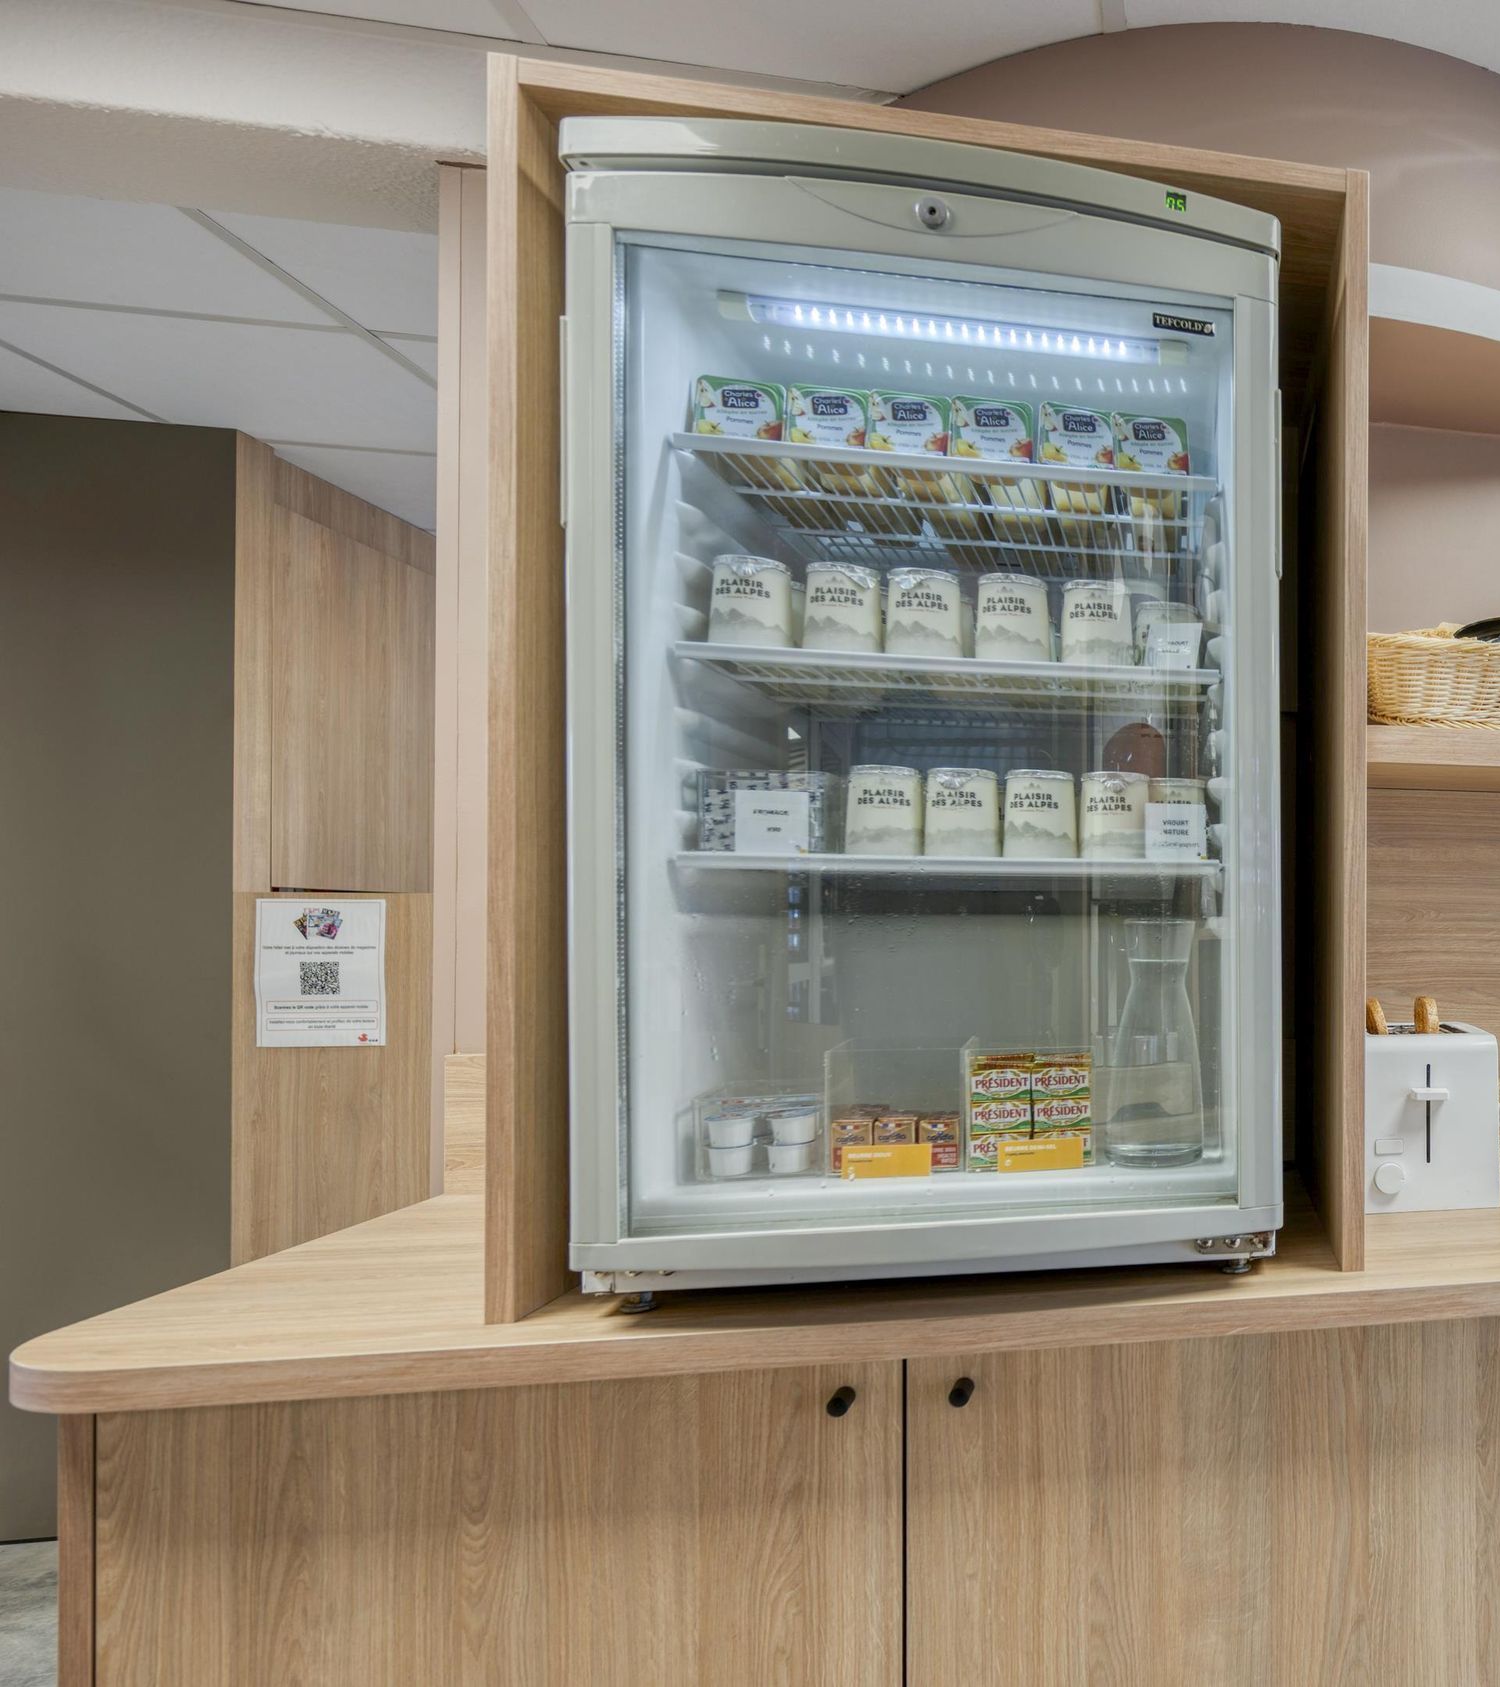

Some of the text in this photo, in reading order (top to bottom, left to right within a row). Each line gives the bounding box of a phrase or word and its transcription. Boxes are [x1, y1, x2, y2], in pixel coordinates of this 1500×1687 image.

[1154, 314, 1203, 331] TEFCOLD
[723, 390, 752, 399] Charles
[727, 398, 756, 408] Alice
[813, 397, 842, 405] Charles
[817, 404, 845, 414] Alice
[897, 410, 924, 420] Alice
[1064, 414, 1090, 422] Charles
[980, 416, 1007, 426] Alice
[1068, 422, 1094, 432] Alice
[1138, 430, 1163, 440] Alice
[720, 579, 763, 589] PLAISIR
[715, 587, 731, 595] DES
[735, 588, 770, 599] ALPES
[815, 587, 857, 596] PLAISIR
[810, 595, 825, 603] DES
[830, 597, 864, 606] ALPES
[901, 592, 942, 601] PLAISIR
[987, 597, 1025, 605] PLAISIR
[916, 602, 948, 611] ALPES
[983, 605, 1031, 614] DES ALPES
[1074, 603, 1113, 611] PLAISIR
[1070, 611, 1085, 619] DES
[863, 789, 905, 797] PLAISIR
[1014, 792, 1052, 800] PLAISIR
[878, 798, 911, 806] ALPES
[1090, 796, 1126, 804] PLAISIR
[1027, 801, 1059, 809] ALPES
[1102, 804, 1132, 812] ALPES
[975, 1076, 1028, 1090] PRÉSIDENT
[1034, 1074, 1087, 1088] PRÉSIDENT
[974, 1107, 1028, 1121] PRÉSIDENT
[1037, 1104, 1088, 1118] PRÉSIDENT
